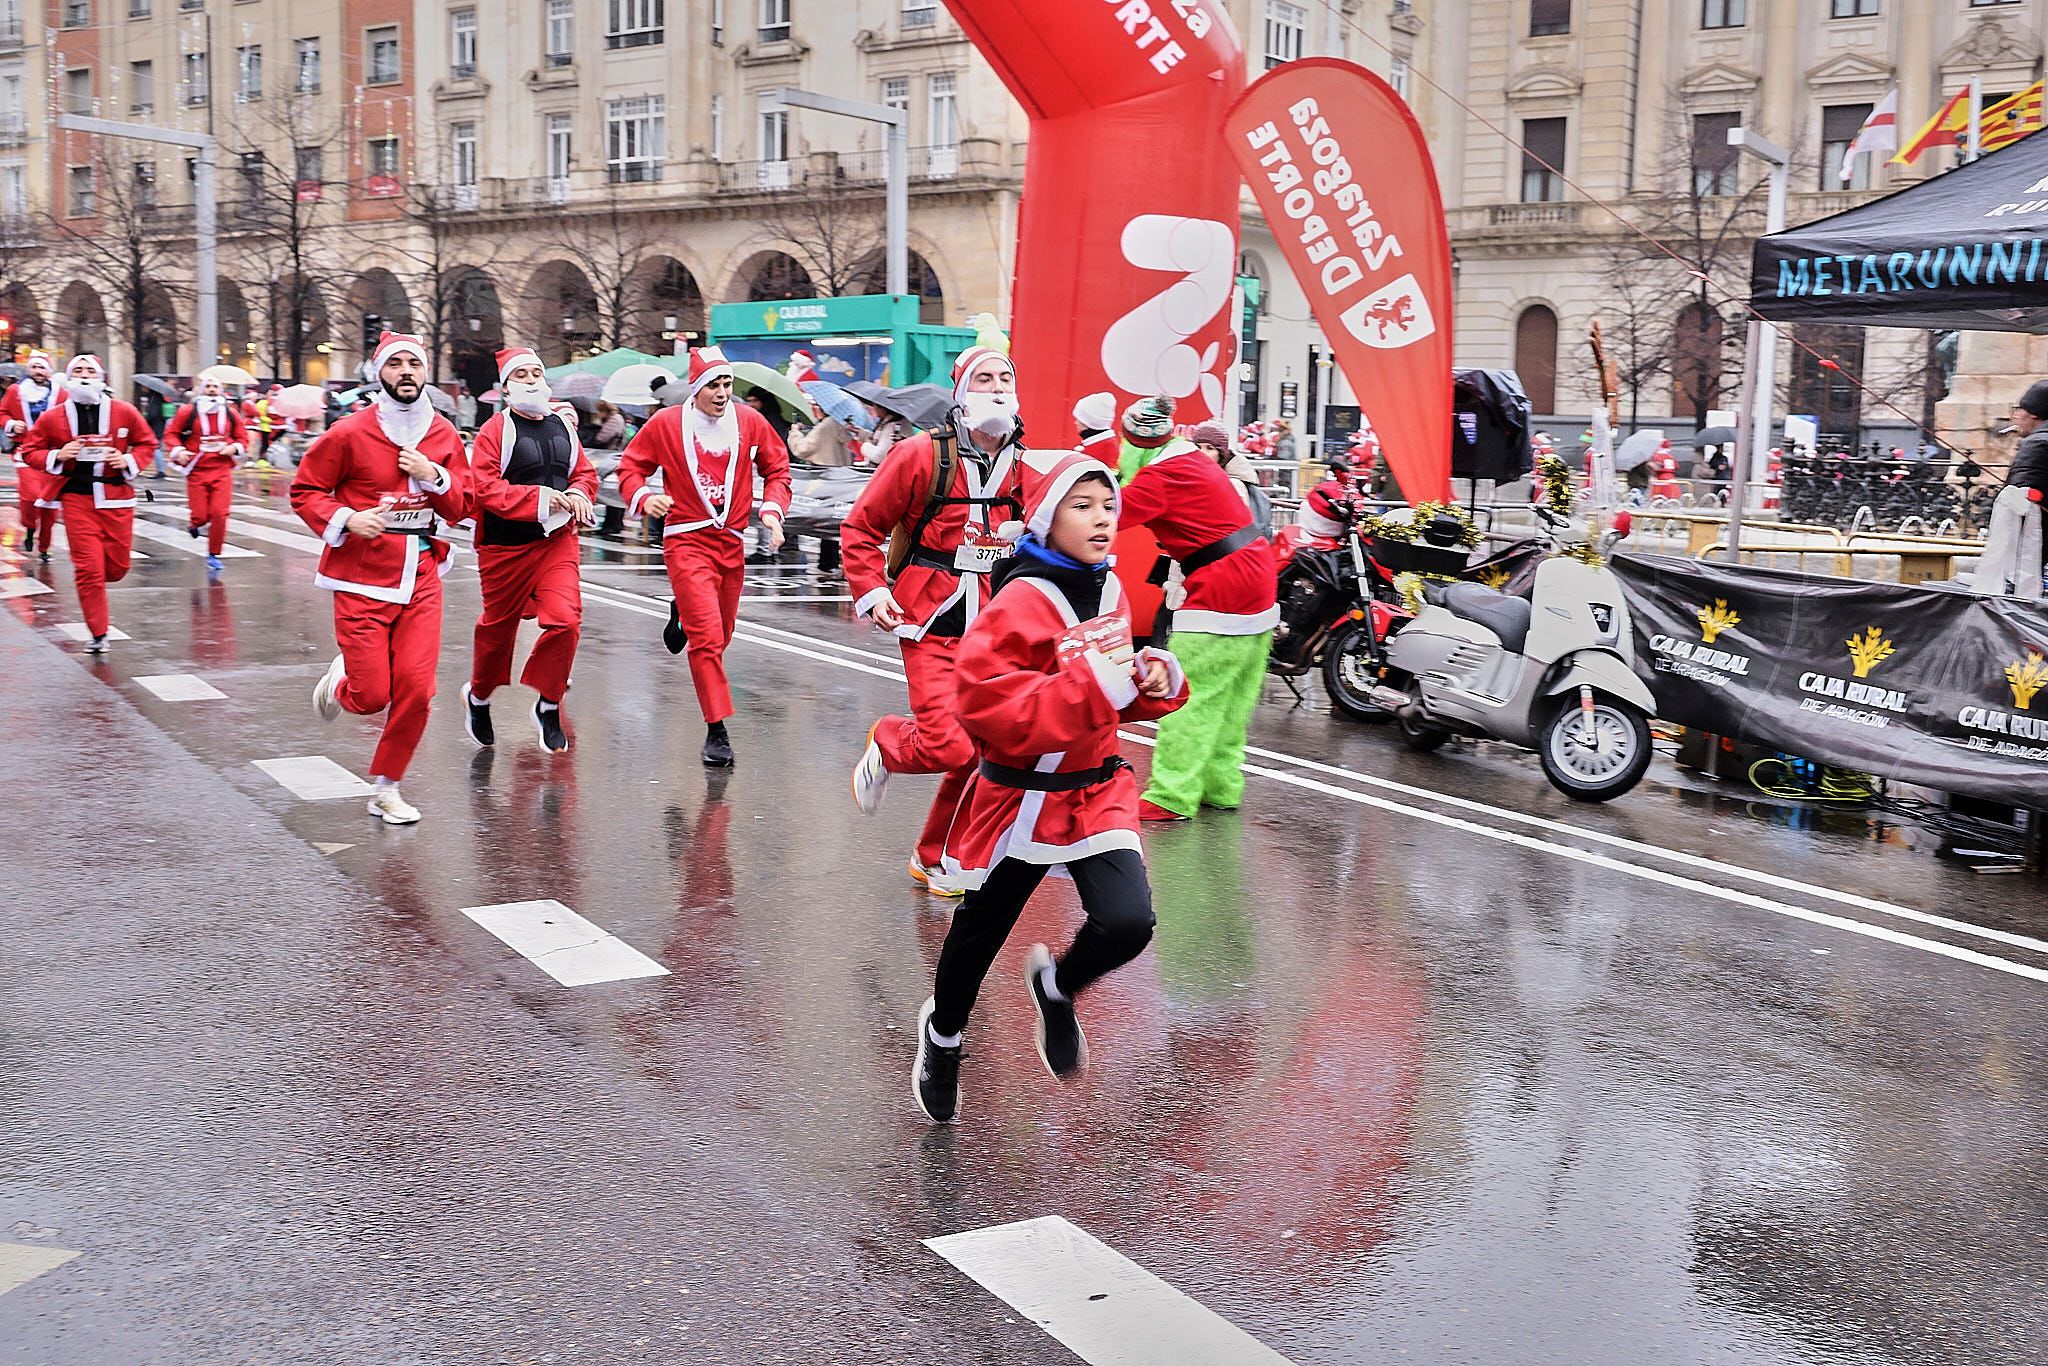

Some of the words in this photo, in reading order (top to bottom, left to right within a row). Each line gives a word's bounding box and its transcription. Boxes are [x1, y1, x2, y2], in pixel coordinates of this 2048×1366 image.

[1107, 0, 1187, 75] RTE
[1776, 238, 2048, 298] METARUNNI
[394, 511, 420, 522] 3774
[976, 548, 1003, 560] 3775
[1649, 634, 1694, 659] CAJA
[1689, 646, 1750, 676] RURAL
[1798, 671, 1846, 699] CAJA
[1844, 681, 1908, 713] RURAL
[1800, 698, 1826, 713] DE
[1820, 703, 1890, 728] ARAGÓN
[1957, 705, 2009, 734] CAJA
[1967, 735, 1993, 752] DE
